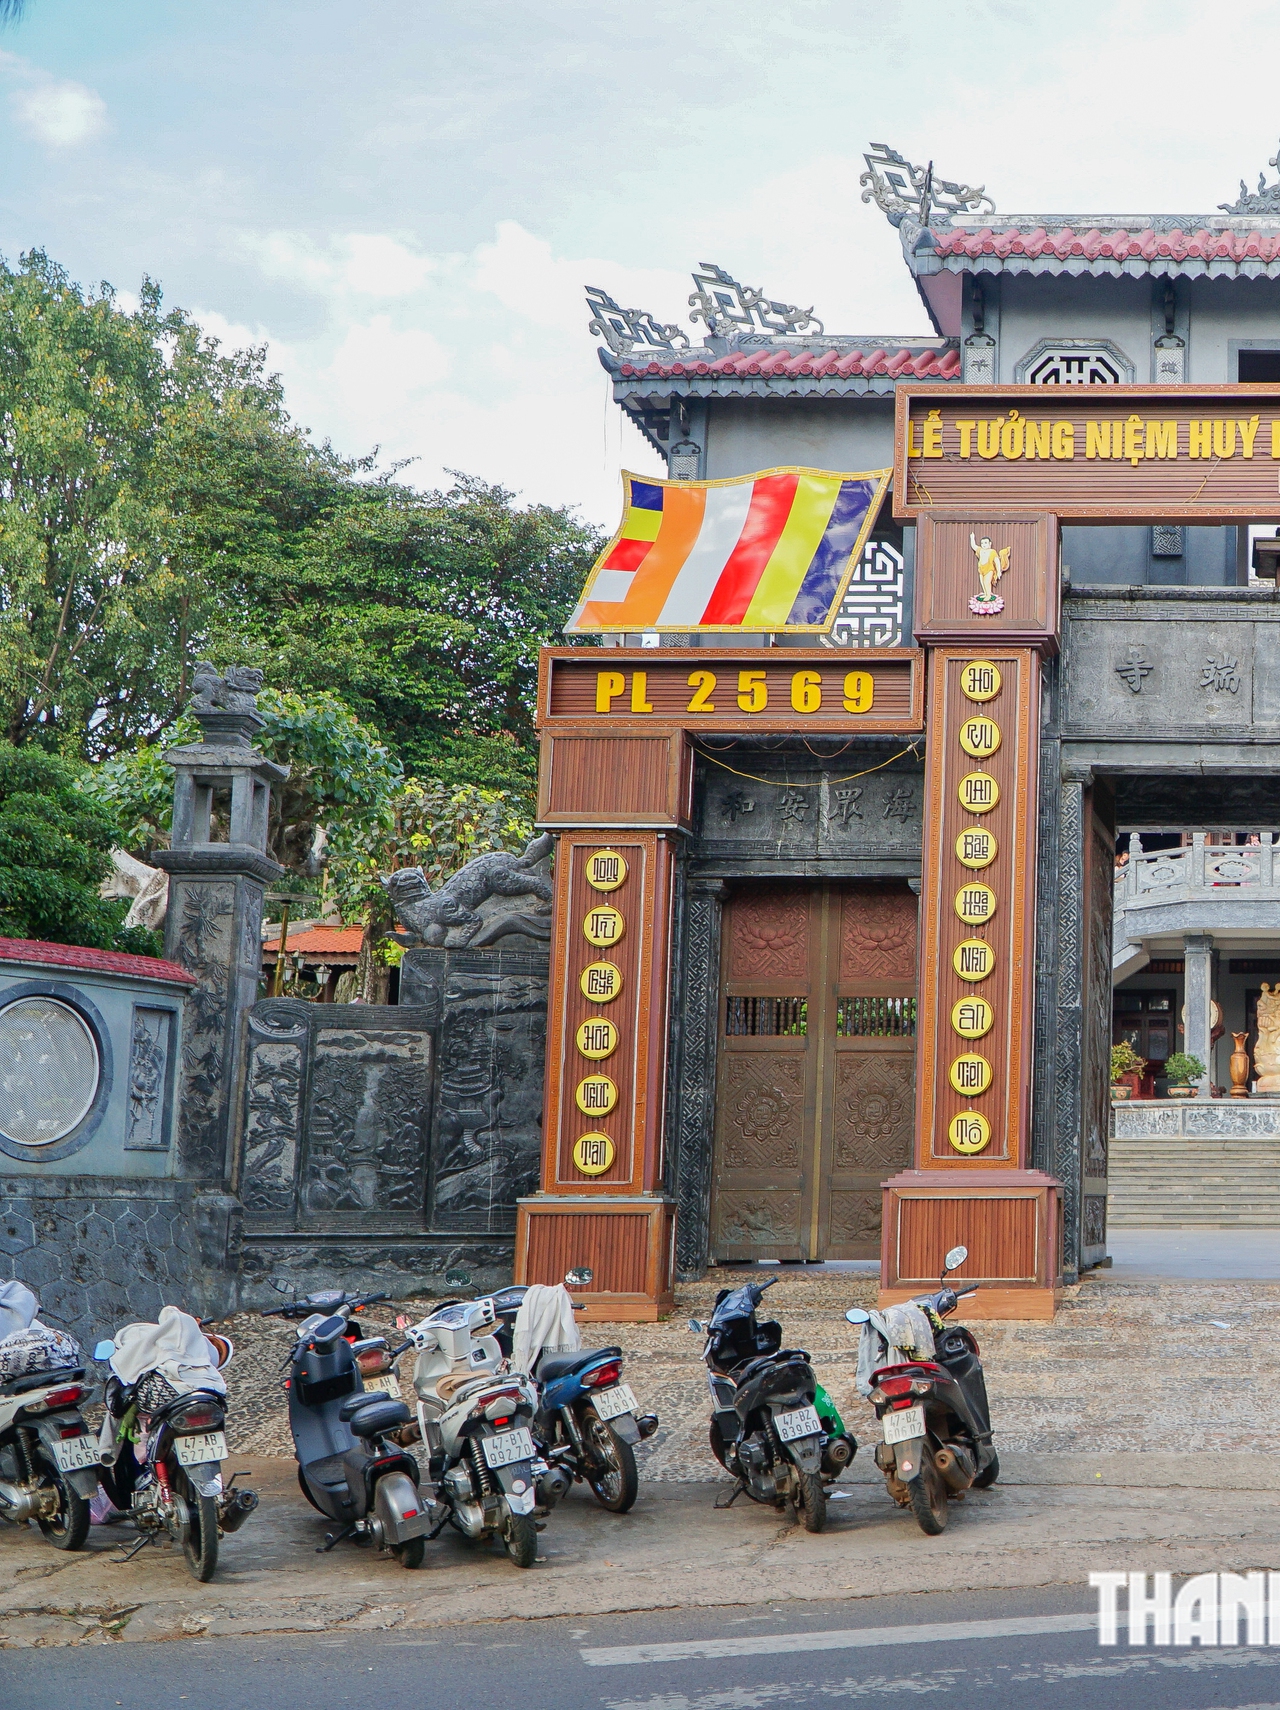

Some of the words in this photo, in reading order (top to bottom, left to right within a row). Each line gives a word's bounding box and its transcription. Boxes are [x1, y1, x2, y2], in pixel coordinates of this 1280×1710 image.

[908, 409, 943, 458] LỄ
[955, 409, 1075, 460] TƯỞNG
[1085, 414, 1177, 467] NIỆM
[1188, 414, 1260, 460] HUÝ
[595, 672, 654, 714] PL
[686, 670, 875, 714] 2569
[366, 1377, 392, 1391] 8-AH
[600, 1387, 627, 1405] 47-H1
[782, 1419, 819, 1439] 839.60
[61, 1438, 92, 1454] 47-AL
[184, 1434, 217, 1449] 47-AB
[492, 1432, 523, 1450] 47-B1
[60, 1449, 100, 1469] 046.56
[181, 1446, 223, 1463] 527.17
[490, 1444, 531, 1465] 992.70
